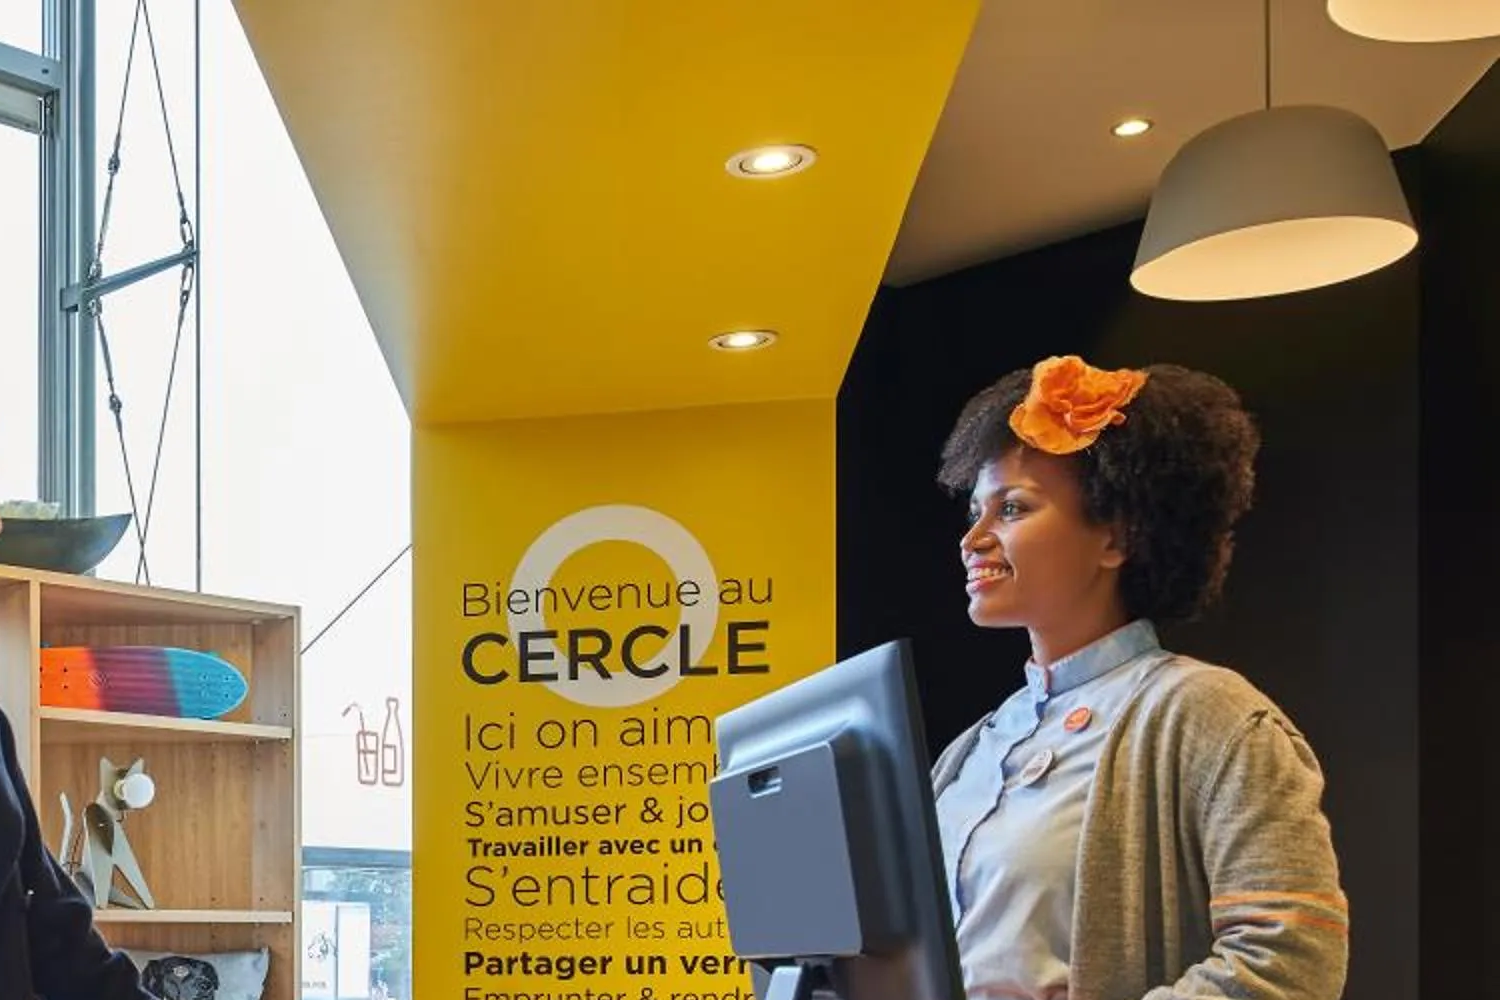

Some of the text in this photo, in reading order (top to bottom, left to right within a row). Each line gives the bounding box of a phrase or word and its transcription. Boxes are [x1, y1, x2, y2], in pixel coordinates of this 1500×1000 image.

[462, 577, 773, 617] Bienvenue au
[461, 620, 770, 685] CERCLE
[465, 707, 712, 751] Ici on aim
[464, 761, 564, 790] Vivre
[465, 795, 709, 829] S'amuser & jo
[467, 836, 589, 858] Travailler
[598, 839, 661, 855] avec
[670, 838, 703, 854] un
[464, 915, 725, 943] Respecter les aut
[464, 951, 749, 981] Partager un verr
